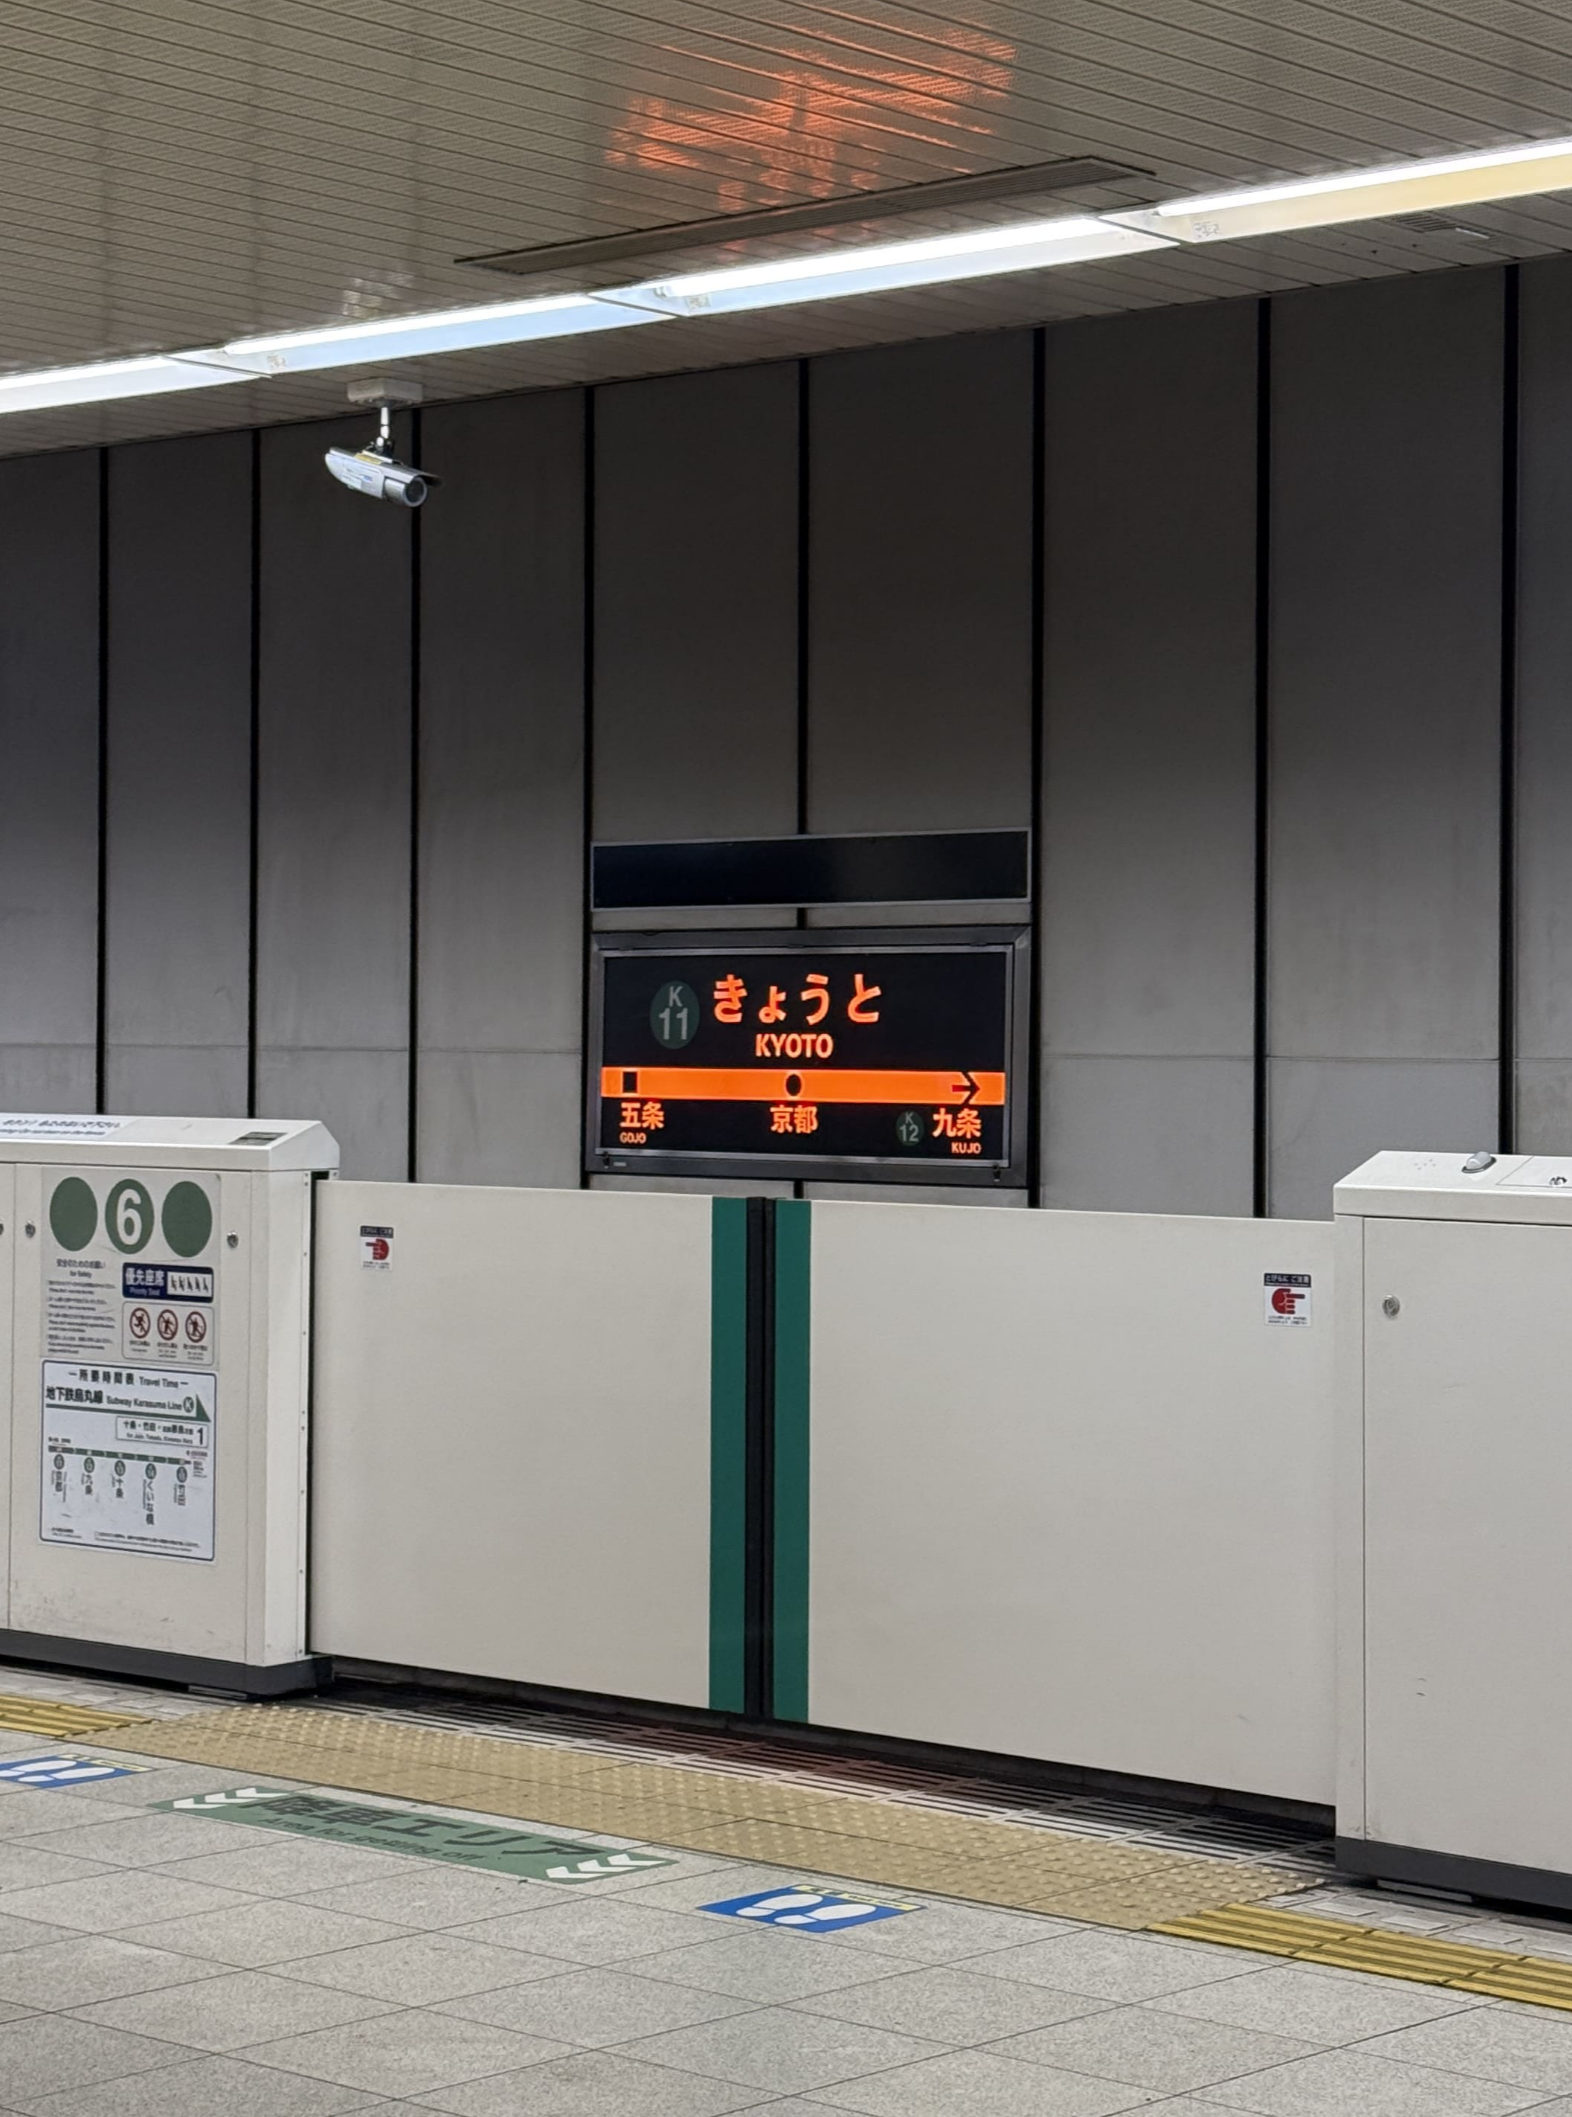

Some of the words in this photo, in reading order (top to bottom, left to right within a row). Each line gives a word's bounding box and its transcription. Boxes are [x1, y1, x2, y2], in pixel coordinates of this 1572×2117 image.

[668, 986, 683, 1007] K
[713, 973, 882, 1025] きょうと
[658, 1008, 689, 1040] 11
[755, 1033, 834, 1059] KYOTO
[619, 1101, 665, 1130] 五条
[769, 1104, 819, 1134] 京都
[904, 1112, 914, 1124] K
[932, 1107, 982, 1139] 九条
[619, 1131, 647, 1144] GOJO
[899, 1124, 919, 1142] 12
[951, 1141, 982, 1154] KUJO
[116, 1188, 142, 1246] 6
[125, 1267, 165, 1287] 優先座席
[139, 1375, 161, 1387] Travel
[161, 1378, 179, 1389] Time
[106, 1395, 132, 1408] Subway
[133, 1398, 167, 1410] Karasuma
[168, 1400, 182, 1411] Line
[258, 1817, 316, 1832] Area
[315, 1826, 356, 1838] for
[348, 1833, 441, 1855] getting
[441, 1851, 487, 1862] off
